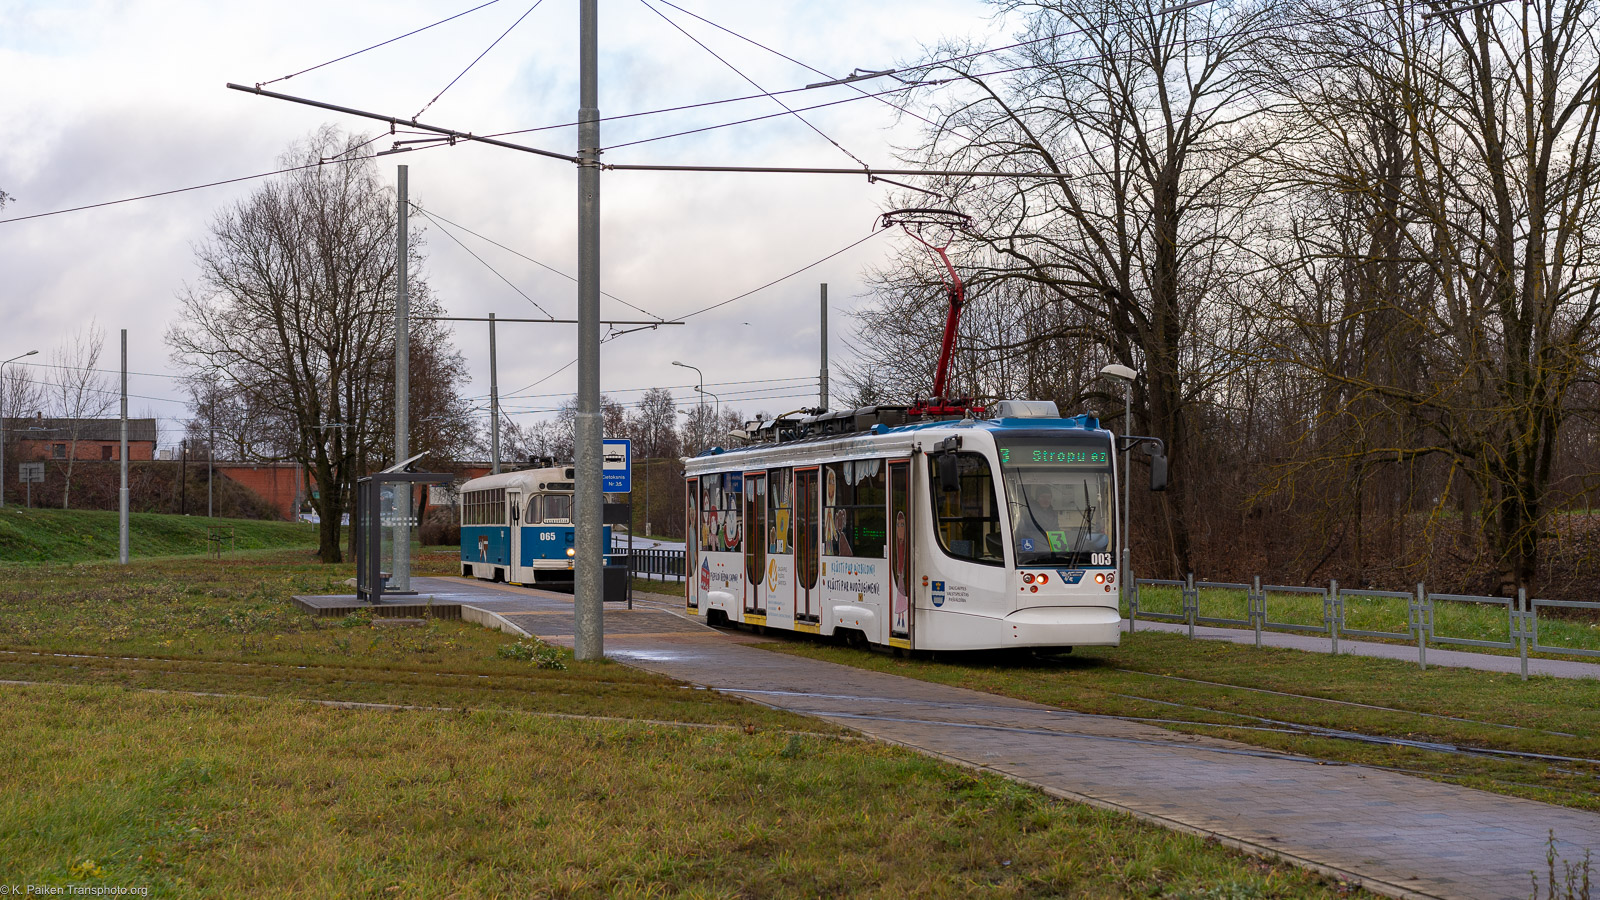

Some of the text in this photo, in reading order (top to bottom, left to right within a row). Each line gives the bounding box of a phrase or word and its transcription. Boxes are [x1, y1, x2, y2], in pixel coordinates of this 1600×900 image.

[1000, 448, 1010, 463] 3
[1033, 450, 1085, 463] Stropu
[540, 532, 556, 541] 065
[1051, 532, 1068, 551] 3
[1091, 552, 1112, 566] 003
